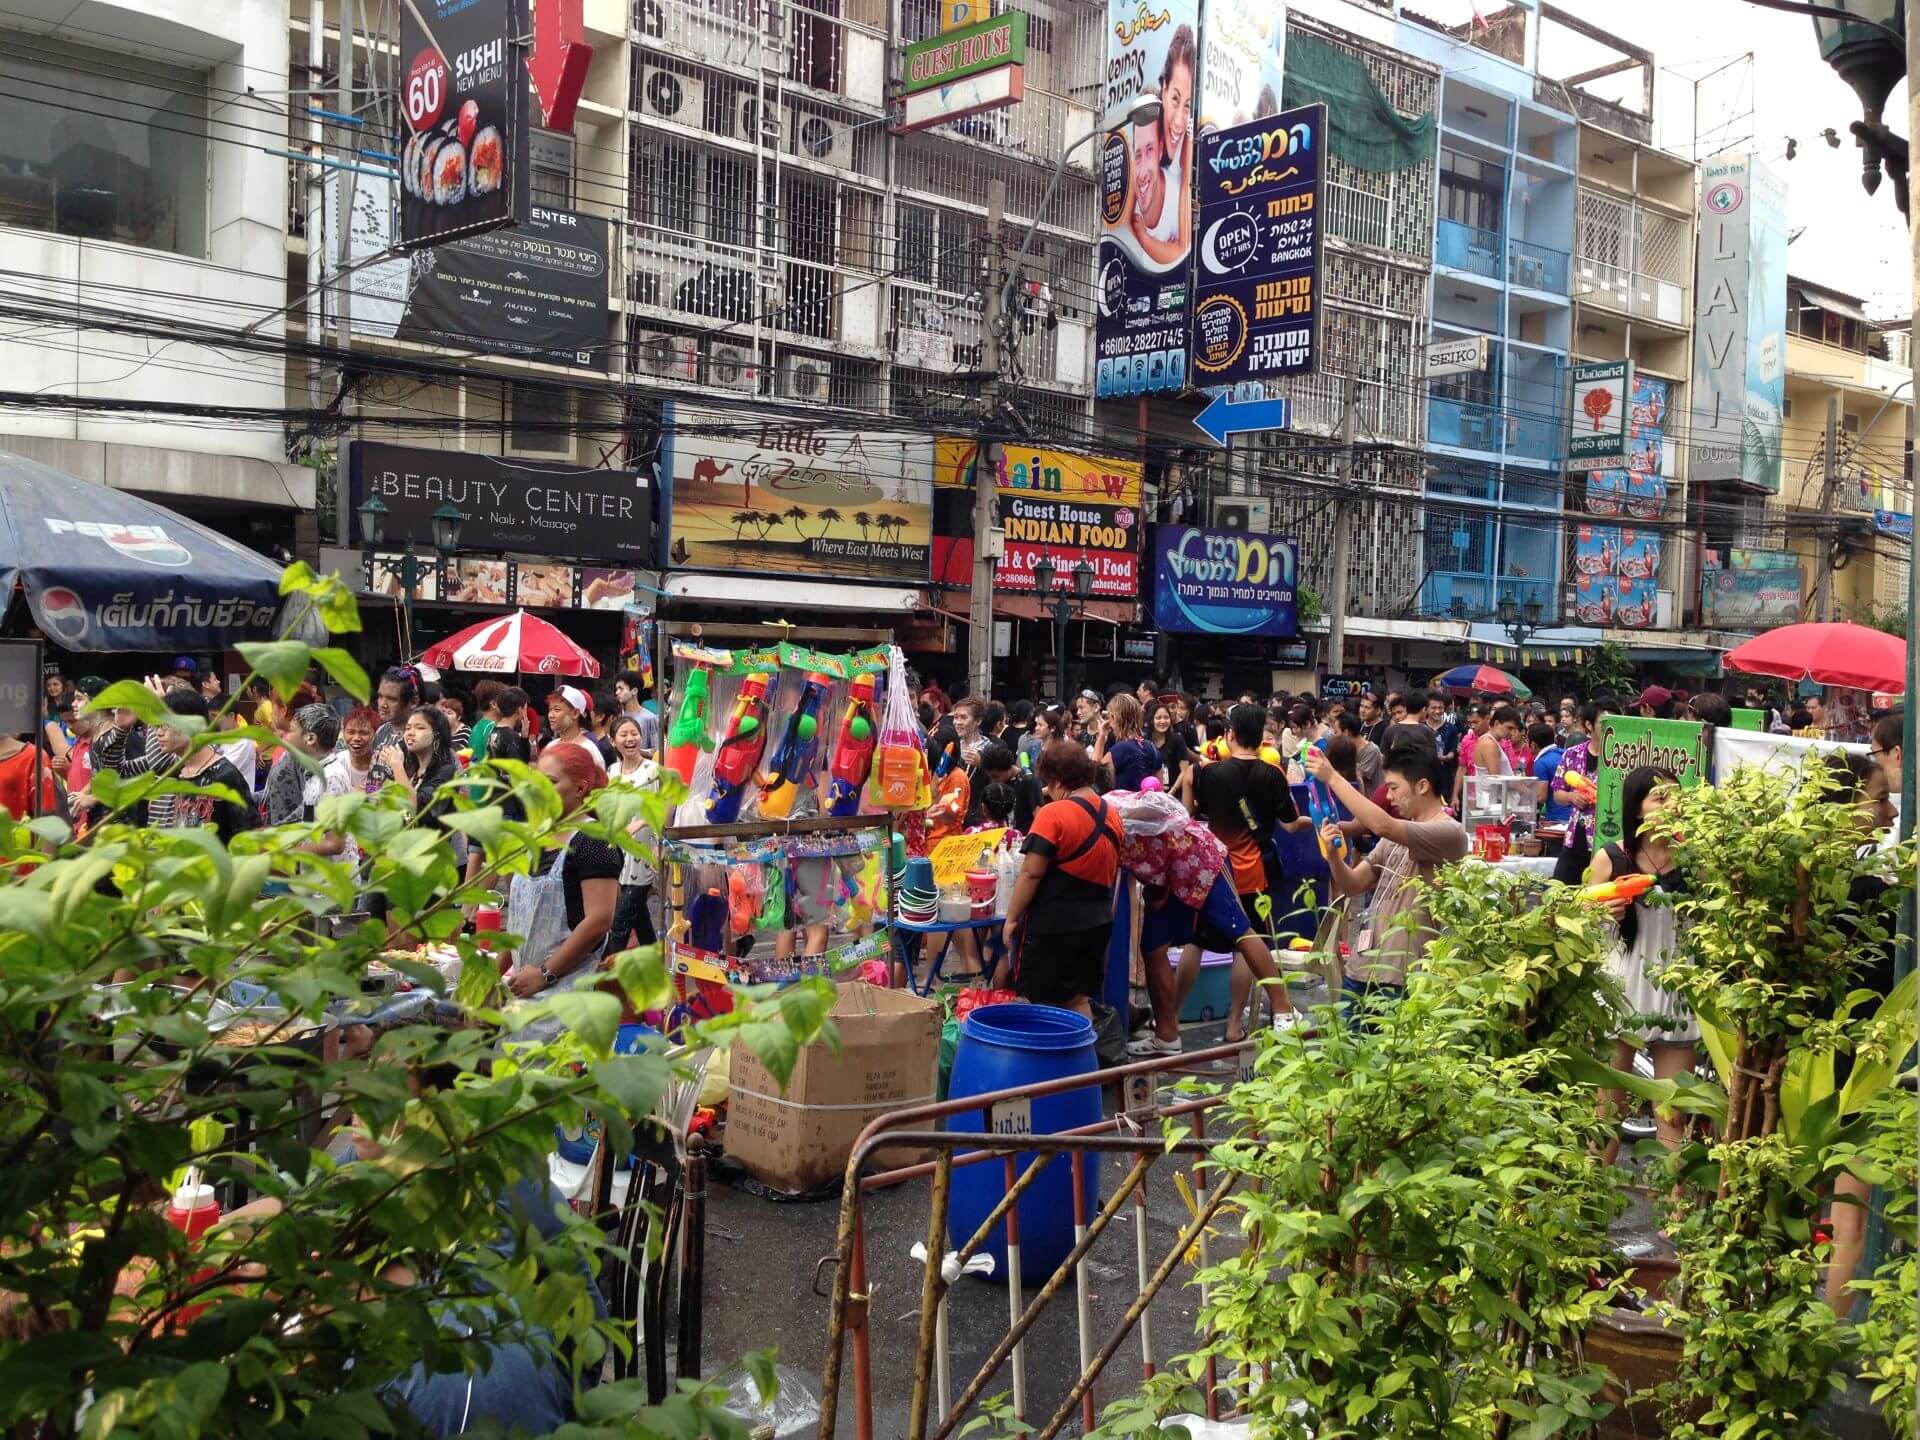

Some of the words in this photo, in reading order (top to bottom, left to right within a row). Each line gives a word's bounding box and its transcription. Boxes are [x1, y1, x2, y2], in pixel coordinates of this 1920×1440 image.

[456, 38, 502, 78] SUSHI
[911, 42, 958, 81] GUEST
[959, 24, 1011, 68] HOUSE
[457, 73, 475, 93] NEW
[479, 63, 502, 86] MENU
[1267, 193, 1313, 218] פתוח
[532, 208, 577, 227] ENTER
[1300, 218, 1312, 229] 24
[1219, 225, 1251, 249] OPEN
[1270, 221, 1298, 238] שעות
[555, 247, 576, 259] סנטר
[1220, 247, 1238, 260] 24/7
[1278, 235, 1303, 250] ימים
[1271, 246, 1312, 263] BANGKOK
[1255, 276, 1311, 301] סוכנות
[1255, 295, 1311, 320] נסיעות
[1254, 329, 1310, 352] מסעדה
[1248, 347, 1310, 371] ישראלית
[1430, 348, 1477, 367] SEIKO
[757, 420, 826, 456] Little
[382, 471, 507, 506] BEAUTY
[526, 487, 633, 519] CENTER
[490, 512, 516, 525] Nails
[530, 515, 577, 534] Massage
[1012, 500, 1055, 521] Guest
[1059, 504, 1100, 525] House
[1004, 517, 1074, 544] INDIAN
[1079, 525, 1127, 549] FOOD
[811, 538, 844, 554] Where
[847, 540, 868, 557] East
[870, 541, 899, 558] Meets
[901, 544, 924, 561] West
[1012, 549, 1022, 568] &
[1103, 558, 1131, 577] Food
[1206, 585, 1229, 599] הנמוך
[1232, 586, 1255, 600] למחיר
[1257, 590, 1292, 602] מתחייבים
